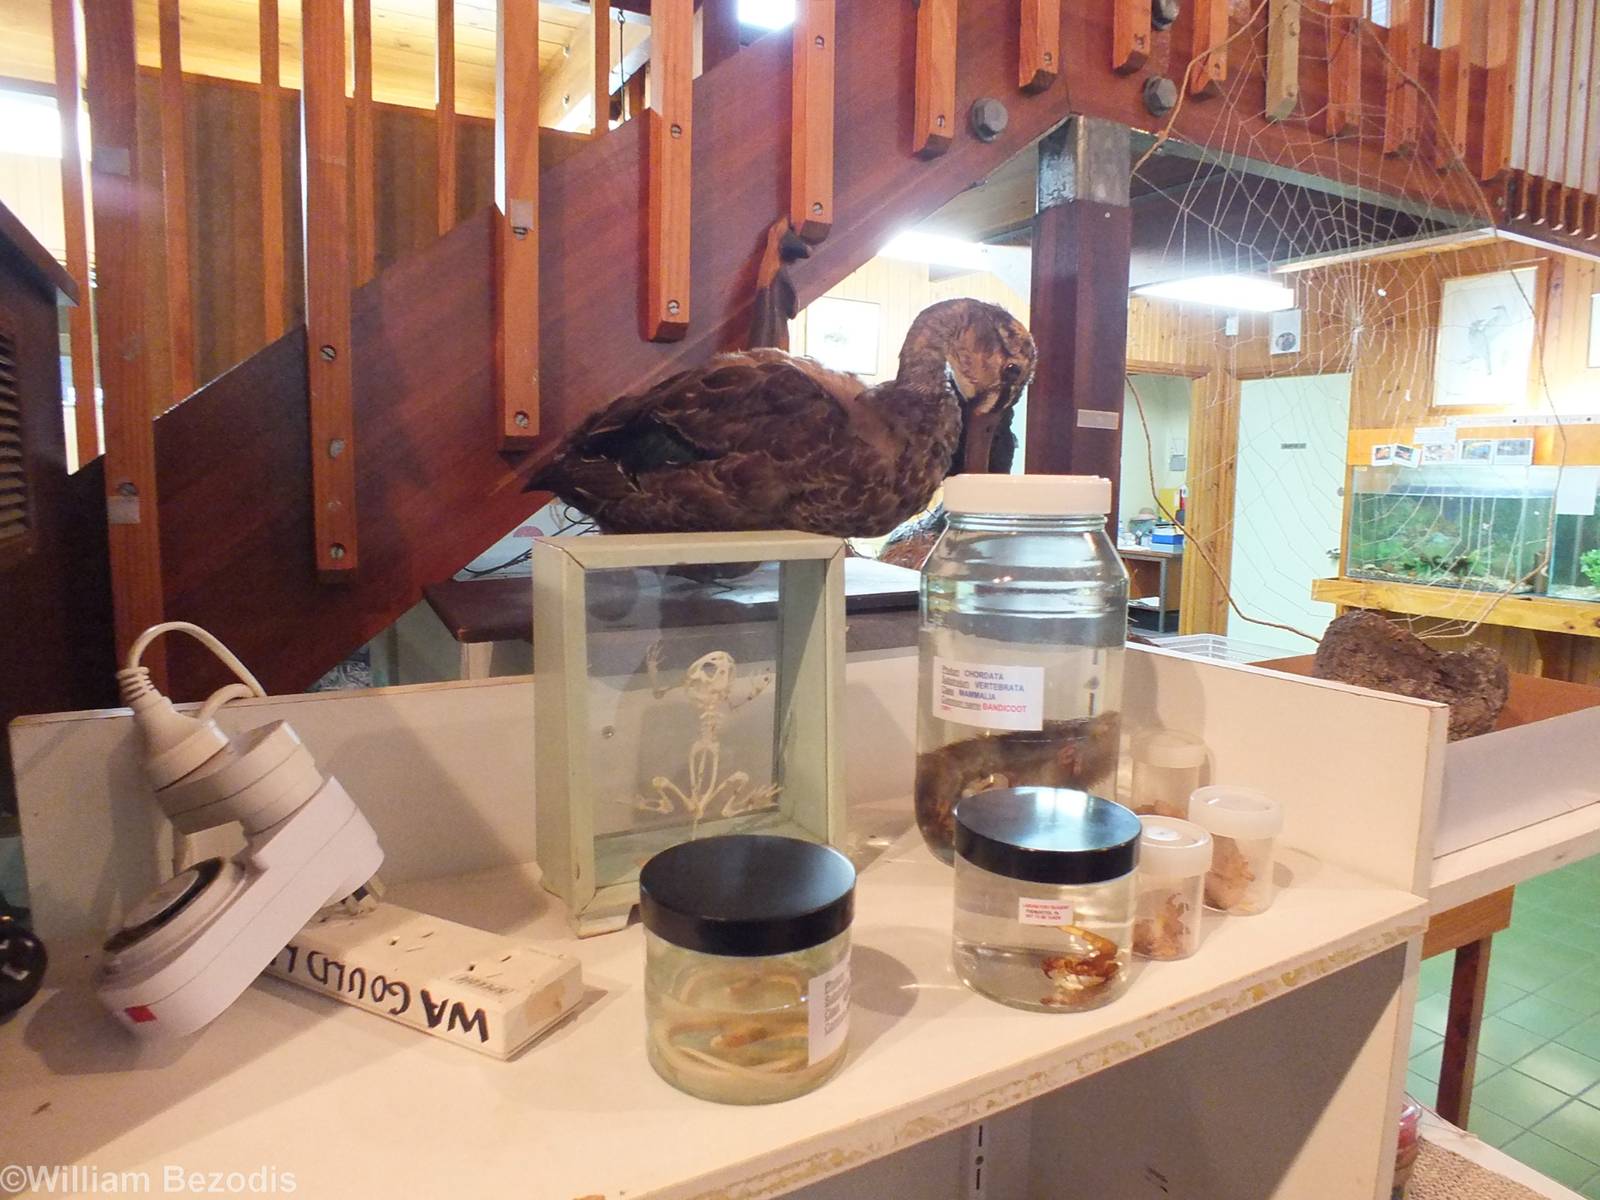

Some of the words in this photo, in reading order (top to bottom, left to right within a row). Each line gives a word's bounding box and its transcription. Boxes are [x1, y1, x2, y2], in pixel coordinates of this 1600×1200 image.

[964, 670, 1005, 680] CHORDATA
[975, 682, 1025, 692] VERTEBRATA
[958, 689, 996, 700] MAMMALIA
[982, 704, 1028, 713] BANDICOOT
[307, 951, 412, 1015] GOULD
[420, 989, 490, 1043] WA
